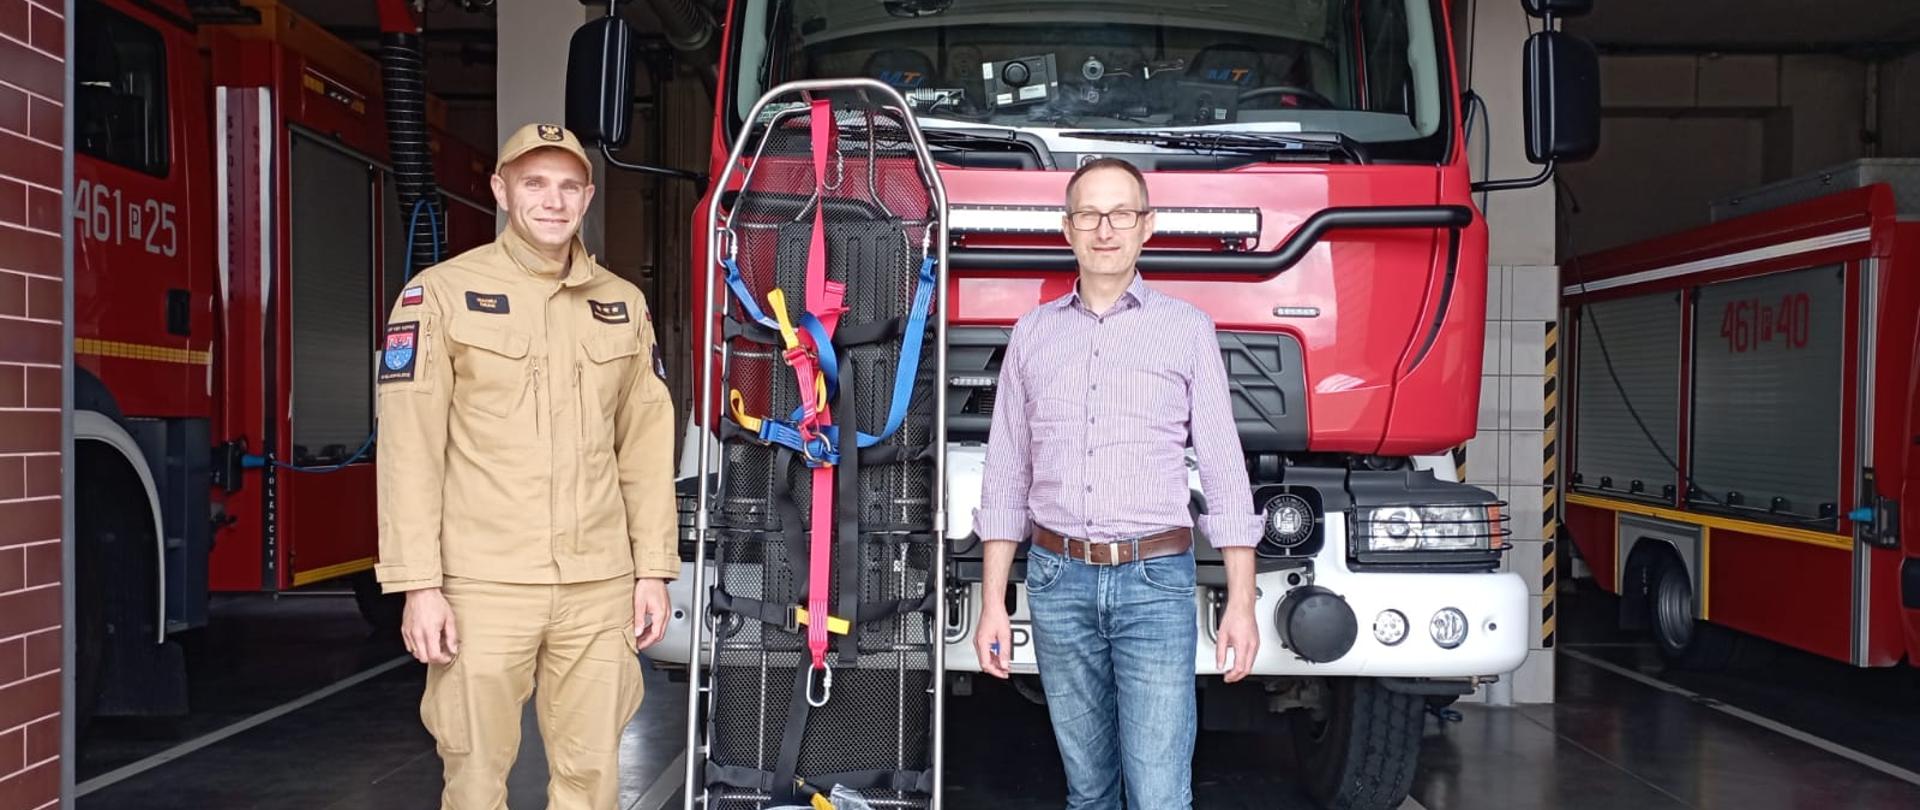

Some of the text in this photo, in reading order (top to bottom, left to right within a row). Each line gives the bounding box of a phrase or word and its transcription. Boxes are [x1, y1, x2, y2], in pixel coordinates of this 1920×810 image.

[145, 198, 177, 257] 25
[1719, 297, 1759, 354] 461
[1776, 292, 1811, 350] 40
[1010, 628, 1029, 660] P
